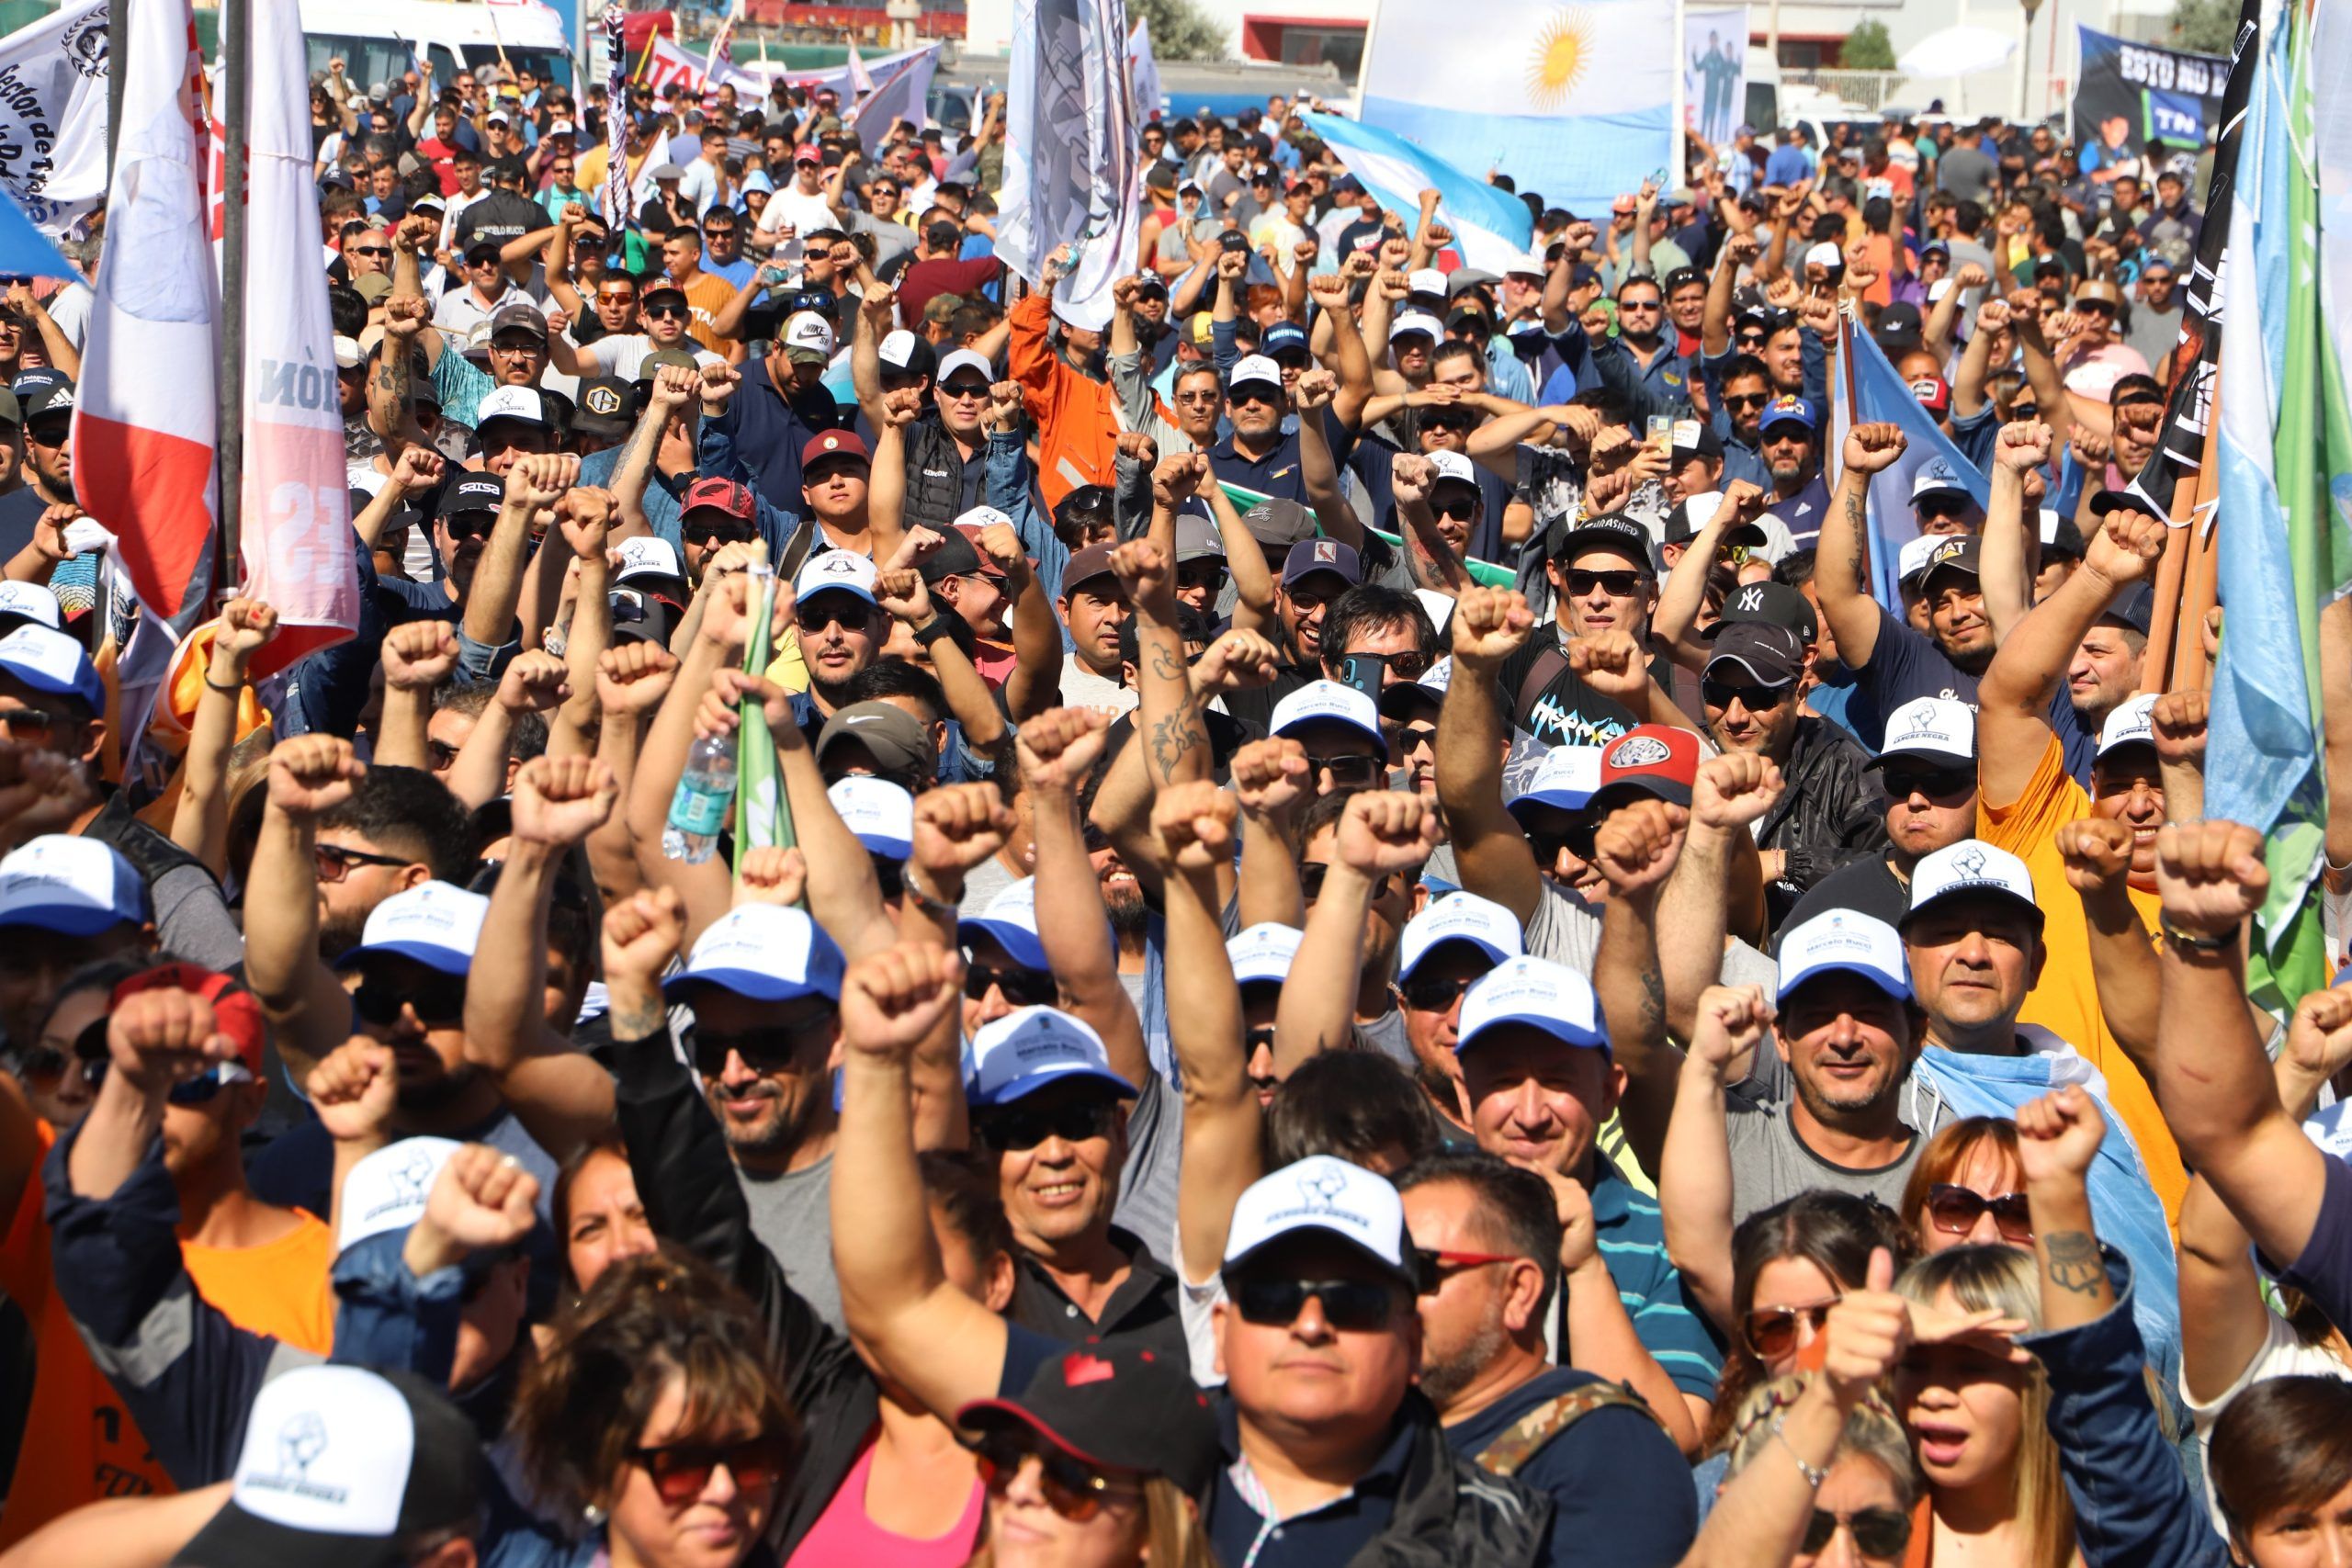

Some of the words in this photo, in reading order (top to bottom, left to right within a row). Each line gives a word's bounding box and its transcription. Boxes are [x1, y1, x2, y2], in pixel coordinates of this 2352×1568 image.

[2120, 45, 2175, 90] ESTO
[2177, 57, 2210, 96] NO
[2154, 107, 2196, 134] TN
[803, 322, 825, 335] NIKE
[819, 336, 830, 346] SB
[1267, 331, 1304, 343] ARGENTINA
[1933, 540, 1967, 563] CAT
[1736, 587, 1765, 612] NY
[1893, 732, 1920, 745] SANGRE
[1921, 732, 1950, 742] NEGRA
[1806, 939, 1843, 954] Marcelo
[1845, 938, 1872, 950] Rucci
[1528, 987, 1558, 998] Rucci
